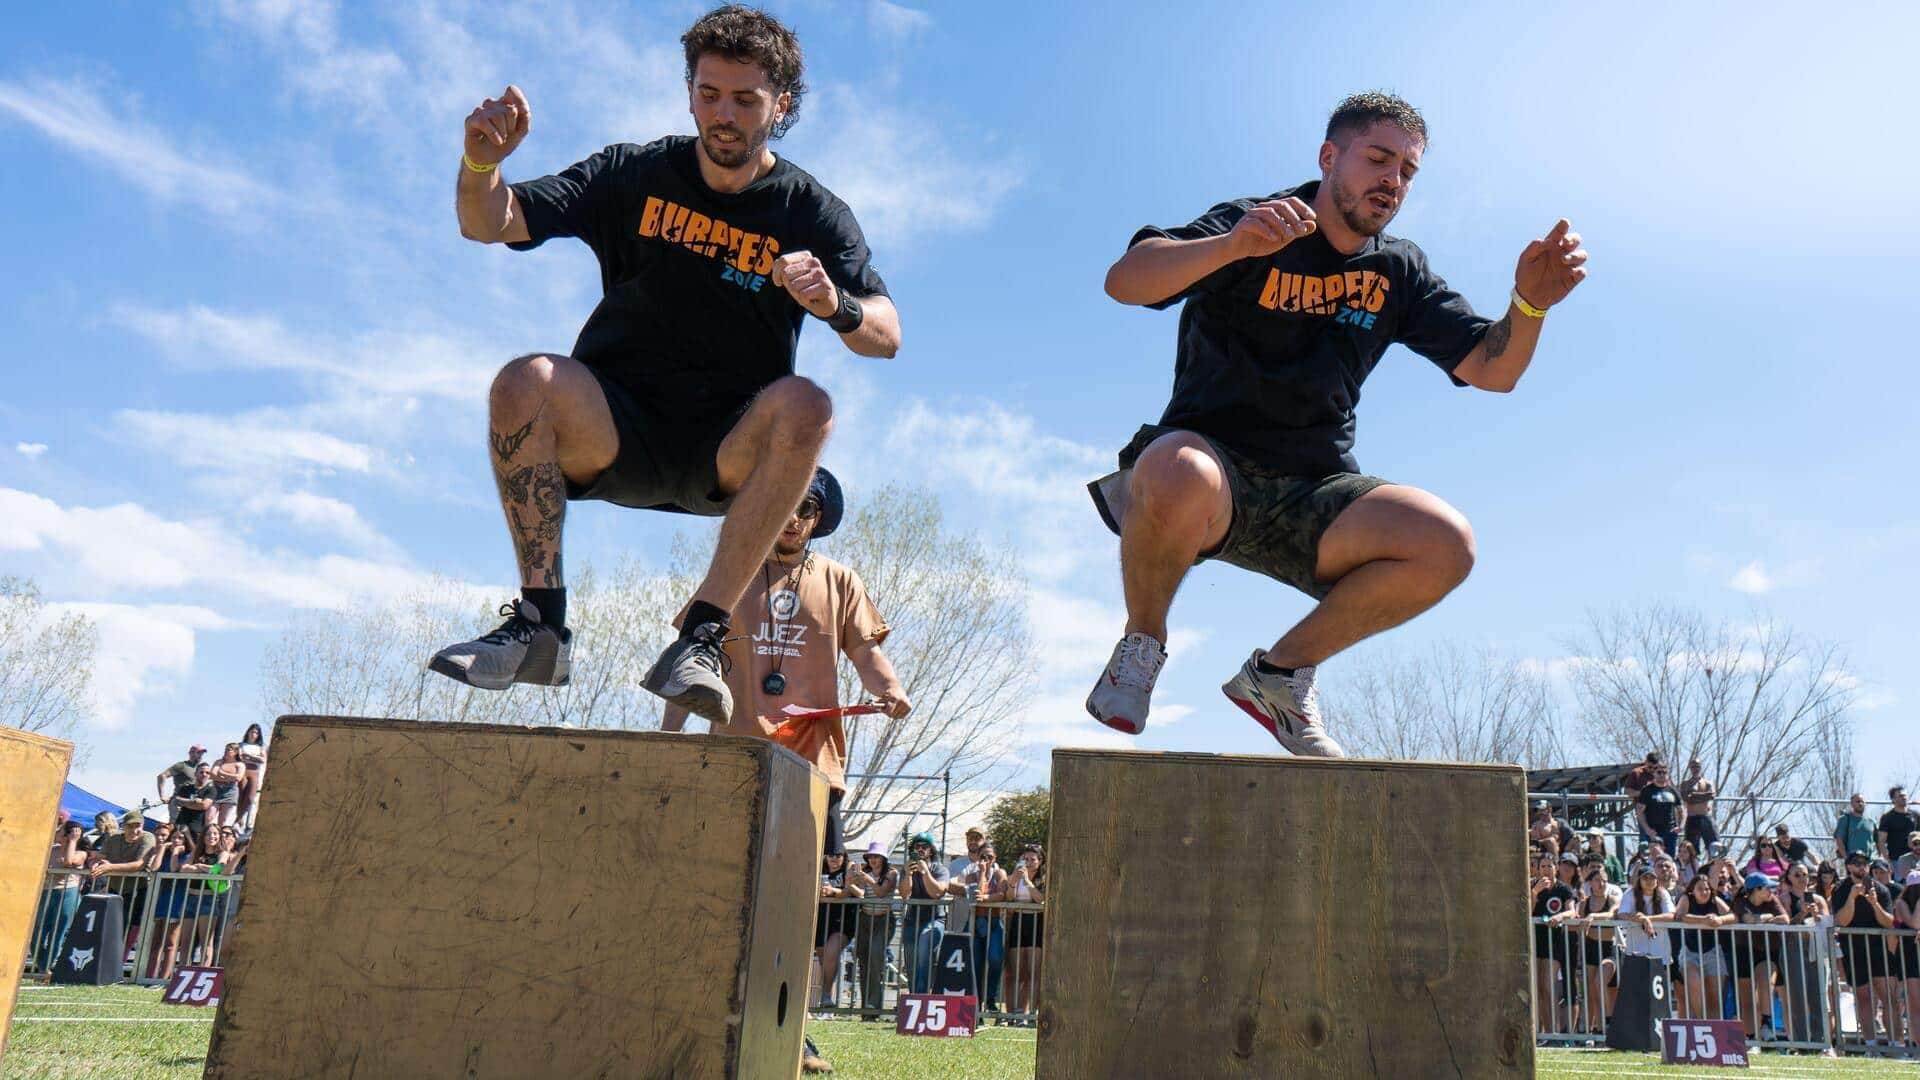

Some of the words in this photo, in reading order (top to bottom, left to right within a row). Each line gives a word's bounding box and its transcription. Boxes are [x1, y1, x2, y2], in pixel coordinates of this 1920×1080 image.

[751, 622, 808, 645] JUEZ
[84, 910, 97, 933] 1
[945, 949, 966, 973] 4
[169, 970, 217, 1003] 7,5
[1652, 975, 1664, 1000] 6
[905, 999, 947, 1033] 7,5
[1669, 1025, 1717, 1061] 7,5
